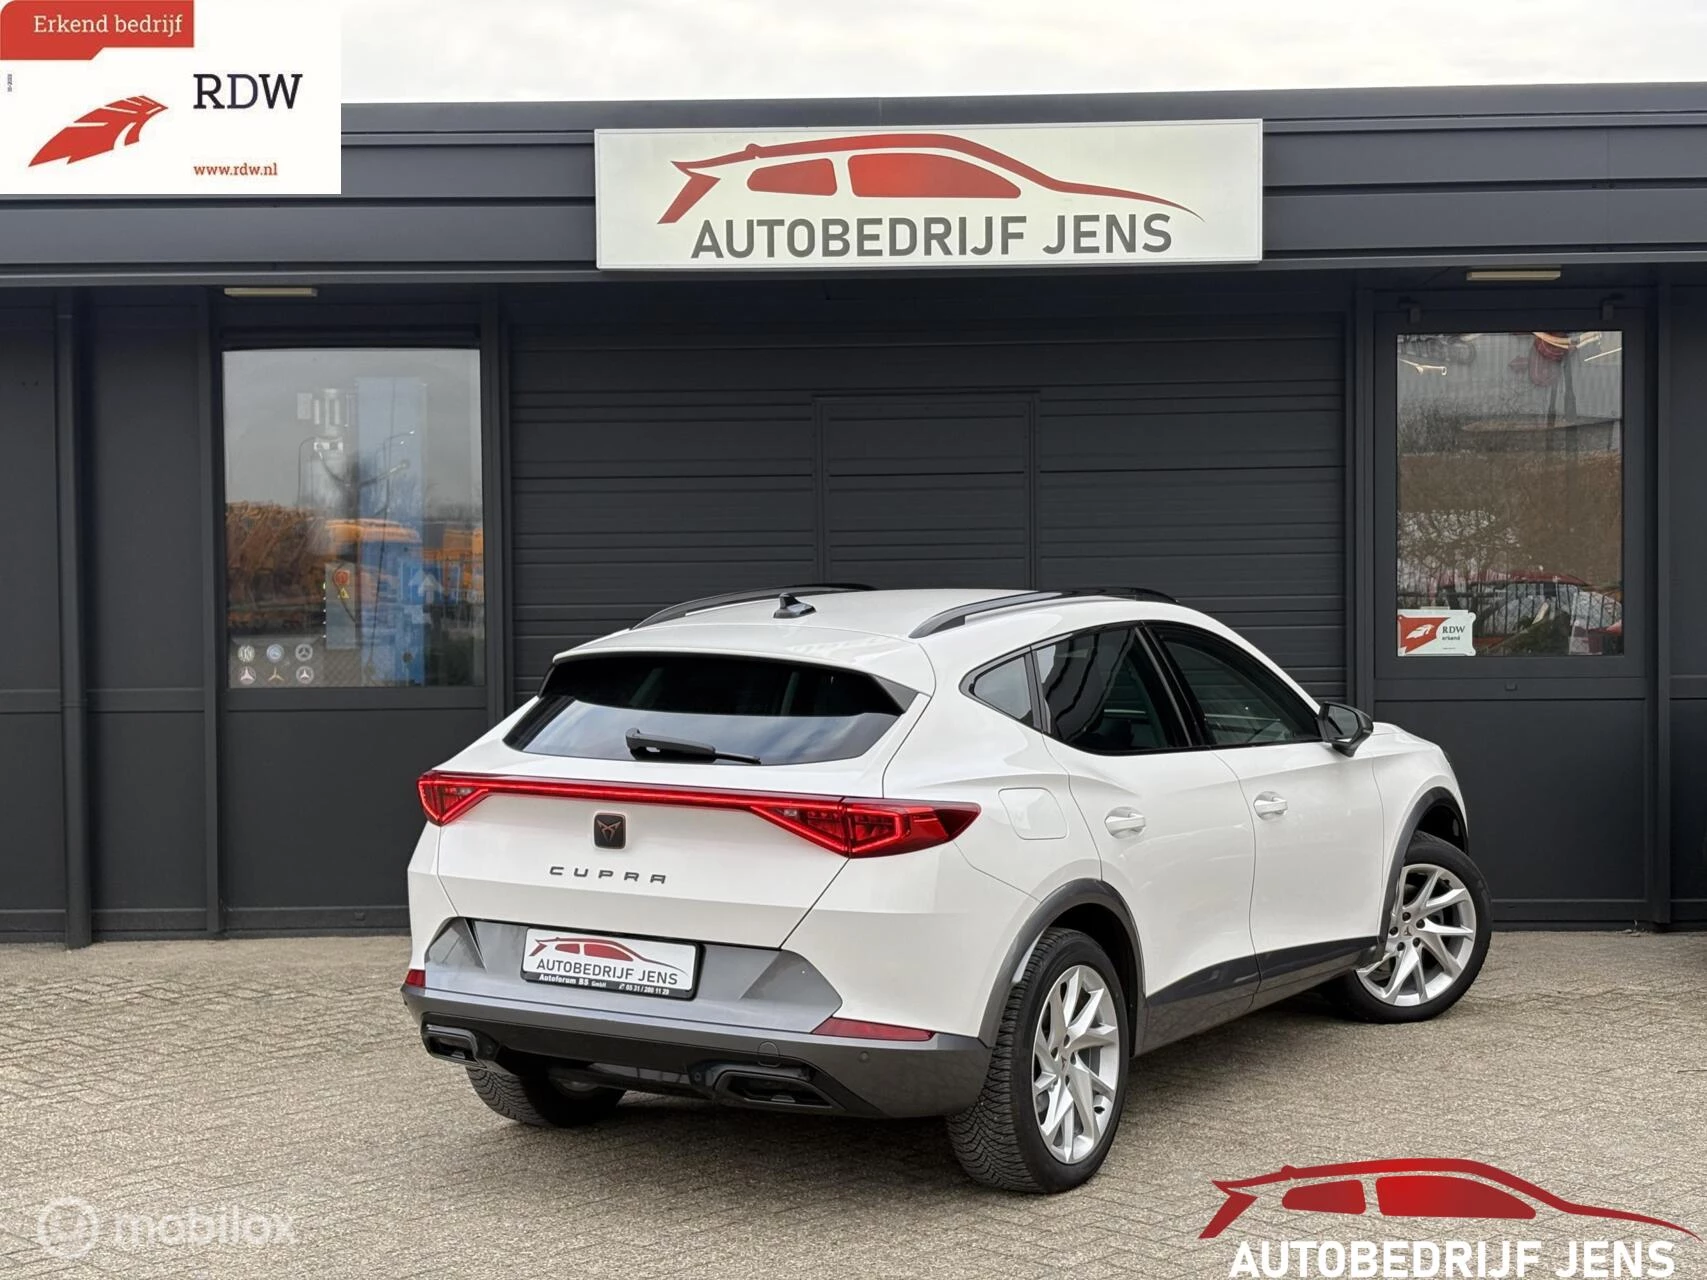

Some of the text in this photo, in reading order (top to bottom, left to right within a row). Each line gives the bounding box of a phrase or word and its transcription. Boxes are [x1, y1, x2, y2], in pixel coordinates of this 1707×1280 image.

[691, 214, 1172, 259] AUTOBEDRIJF JENS
[1442, 626, 1465, 634] RDW
[549, 866, 666, 885] CUPRA
[536, 958, 678, 985] AUTOBEDRIJF JENS
[538, 973, 577, 984] Autoforum
